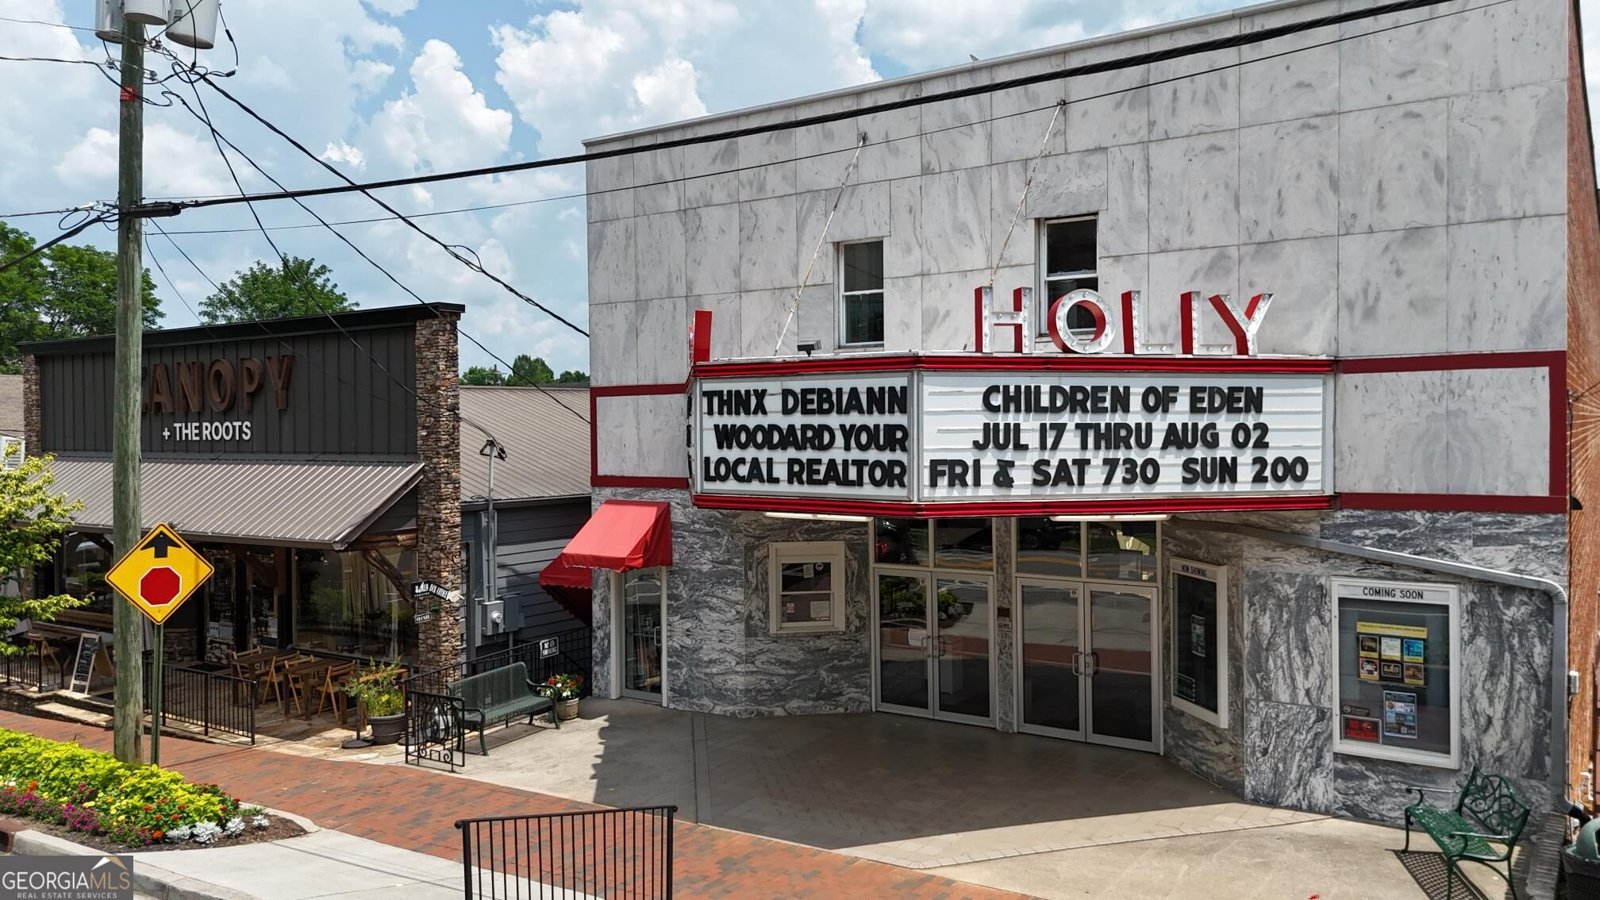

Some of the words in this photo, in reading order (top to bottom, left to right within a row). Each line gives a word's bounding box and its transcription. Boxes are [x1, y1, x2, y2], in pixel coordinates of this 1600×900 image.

[975, 286, 1273, 356] HOLLY
[702, 389, 768, 416] THNX
[982, 385, 1131, 414] CHILDREN
[1141, 386, 1179, 414] OF
[1189, 386, 1263, 414] EDEN
[173, 422, 200, 441] THE
[202, 421, 252, 441] ROOTS
[713, 424, 836, 451] WOODARD
[839, 424, 909, 452] YOUR
[972, 422, 1029, 451] JUL
[1039, 422, 1068, 451] 17
[1075, 422, 1153, 451] THRU
[1160, 422, 1220, 450] AUG
[1231, 422, 1270, 449] 02
[704, 456, 780, 484] LOCAL
[787, 458, 907, 487] REALTOR
[929, 458, 981, 488] FRI
[993, 459, 1016, 488] &
[1032, 458, 1091, 487] SAT
[1102, 457, 1161, 486] 730
[1181, 456, 1238, 485] SUN
[1251, 456, 1309, 484] 200
[1362, 586, 1397, 598] COMING
[1400, 589, 1424, 600] SOON
